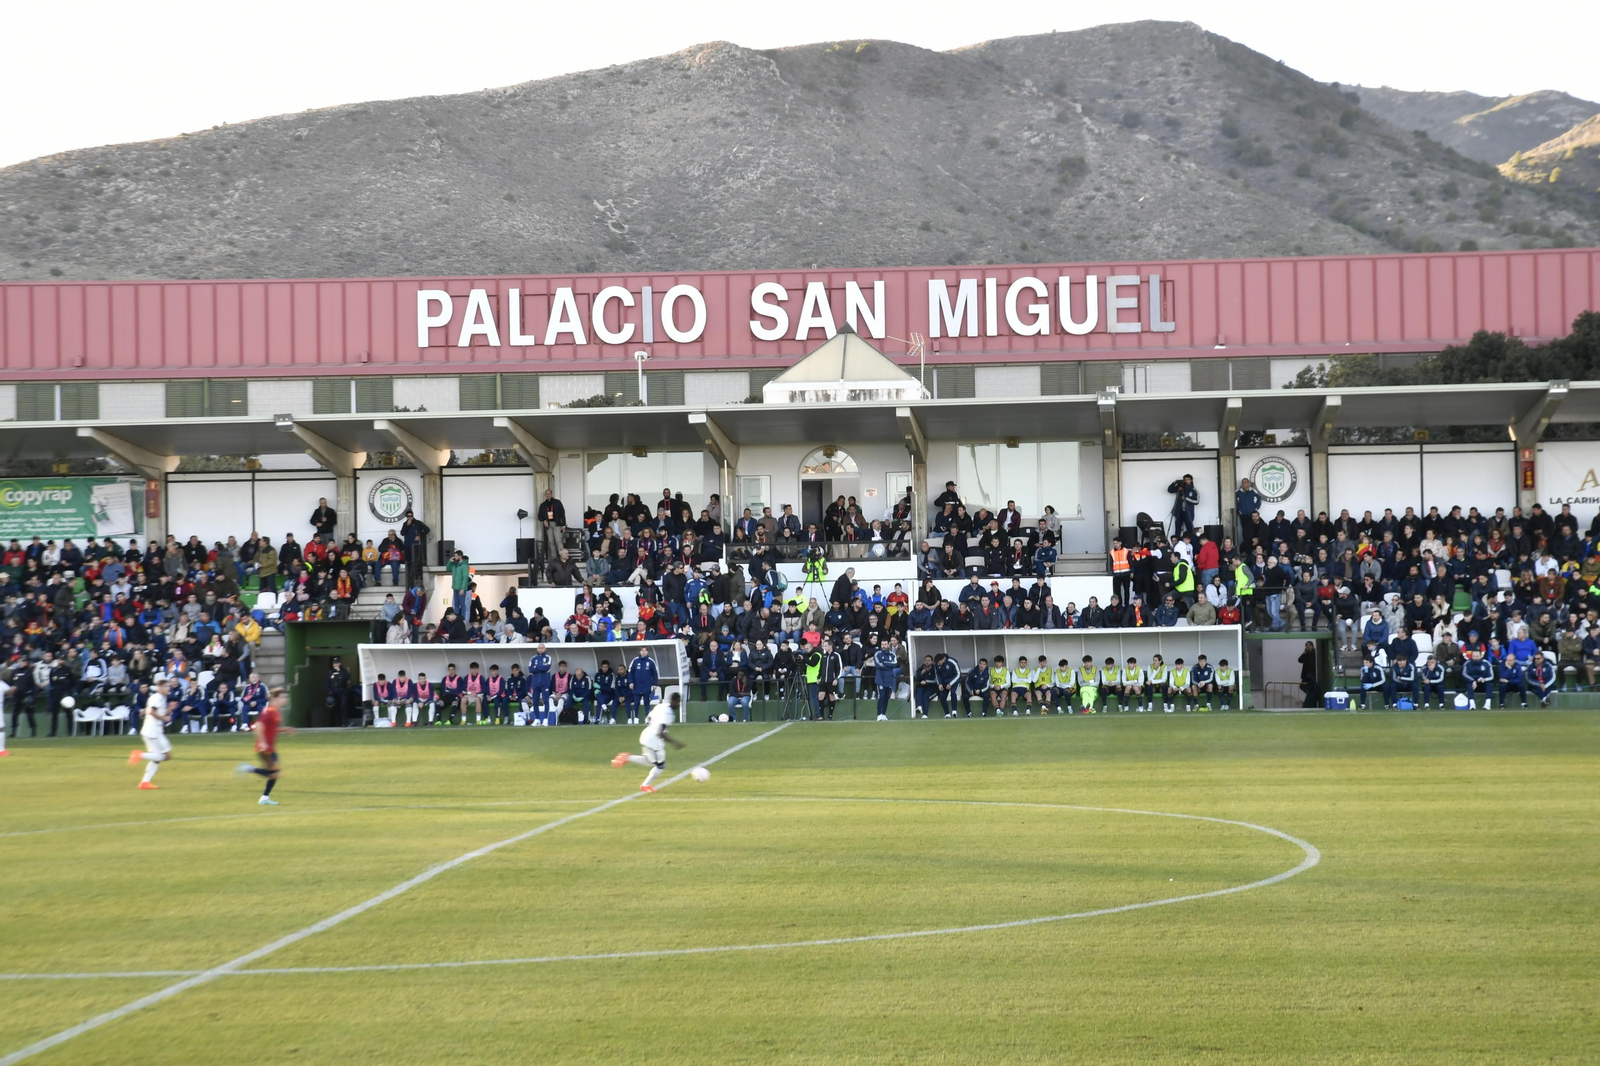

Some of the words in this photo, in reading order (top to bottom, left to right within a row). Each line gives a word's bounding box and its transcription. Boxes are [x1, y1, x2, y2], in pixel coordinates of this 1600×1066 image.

[417, 284, 707, 347] PALACIO
[749, 280, 885, 341] SAN
[928, 274, 1176, 337] MIGUEL
[1250, 460, 1263, 483] JUVENTUD
[1262, 456, 1295, 473] TORREMOLINOS
[5, 489, 73, 505] copyrap
[369, 482, 382, 503] JUVENTUD
[381, 479, 410, 495] TORREMOLINOS
[1549, 497, 1563, 505] LA
